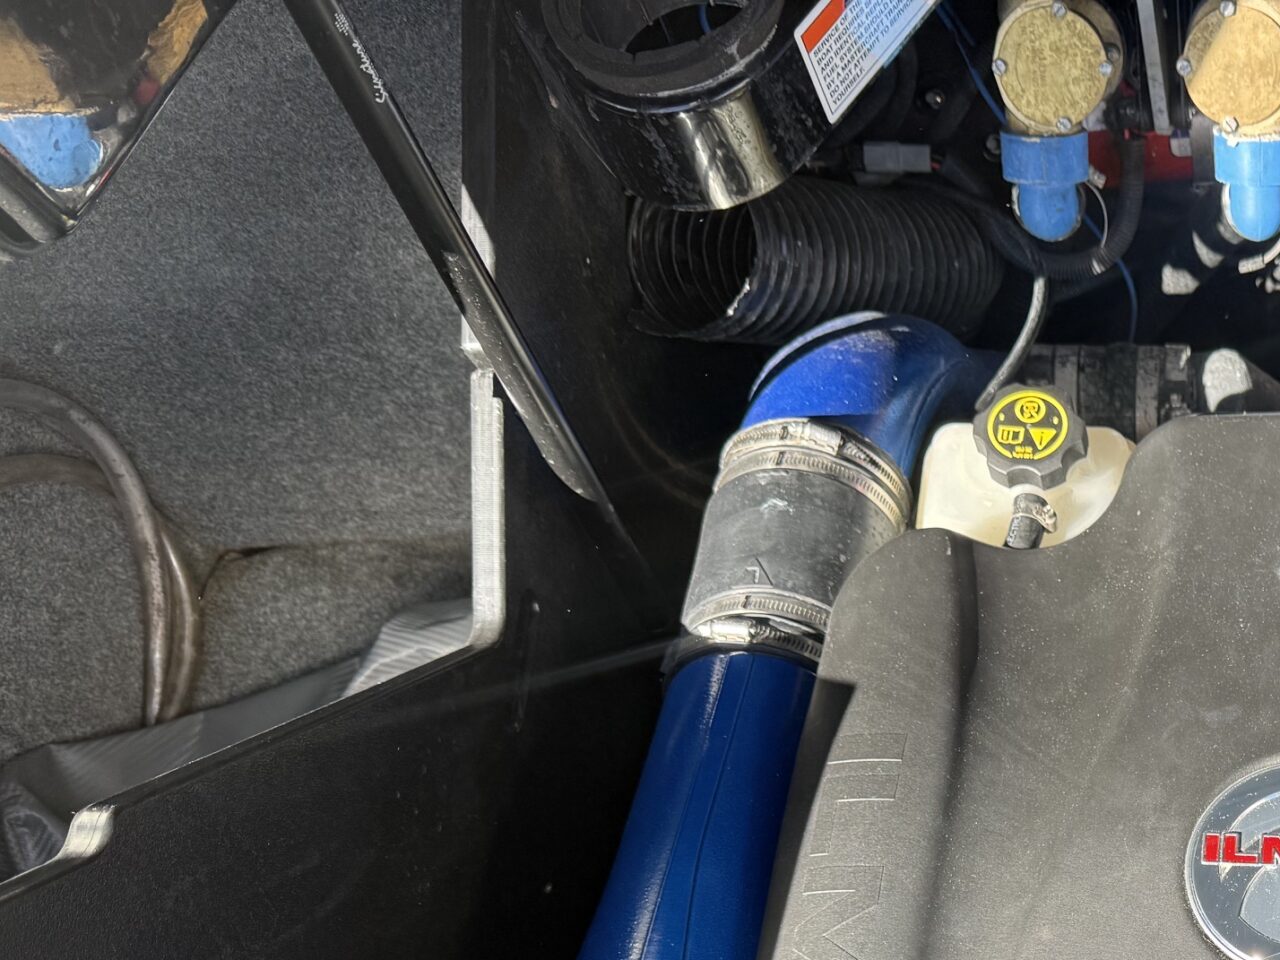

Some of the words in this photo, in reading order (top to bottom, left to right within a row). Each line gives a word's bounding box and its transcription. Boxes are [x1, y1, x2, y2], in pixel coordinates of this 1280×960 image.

[813, 23, 839, 57] SERVICE
[816, 42, 832, 65] BOAT
[834, 6, 865, 45] REQUIRES
[821, 56, 833, 74] AND
[834, 20, 866, 57] IDENTICAL
[823, 62, 839, 82] FUEL
[839, 31, 863, 63] SYSTEM
[826, 76, 834, 89] BY
[840, 17, 883, 72] MASTERCRAFT
[829, 84, 839, 98] DO
[839, 67, 851, 85] NOT
[853, 34, 879, 70] ATTEMPT
